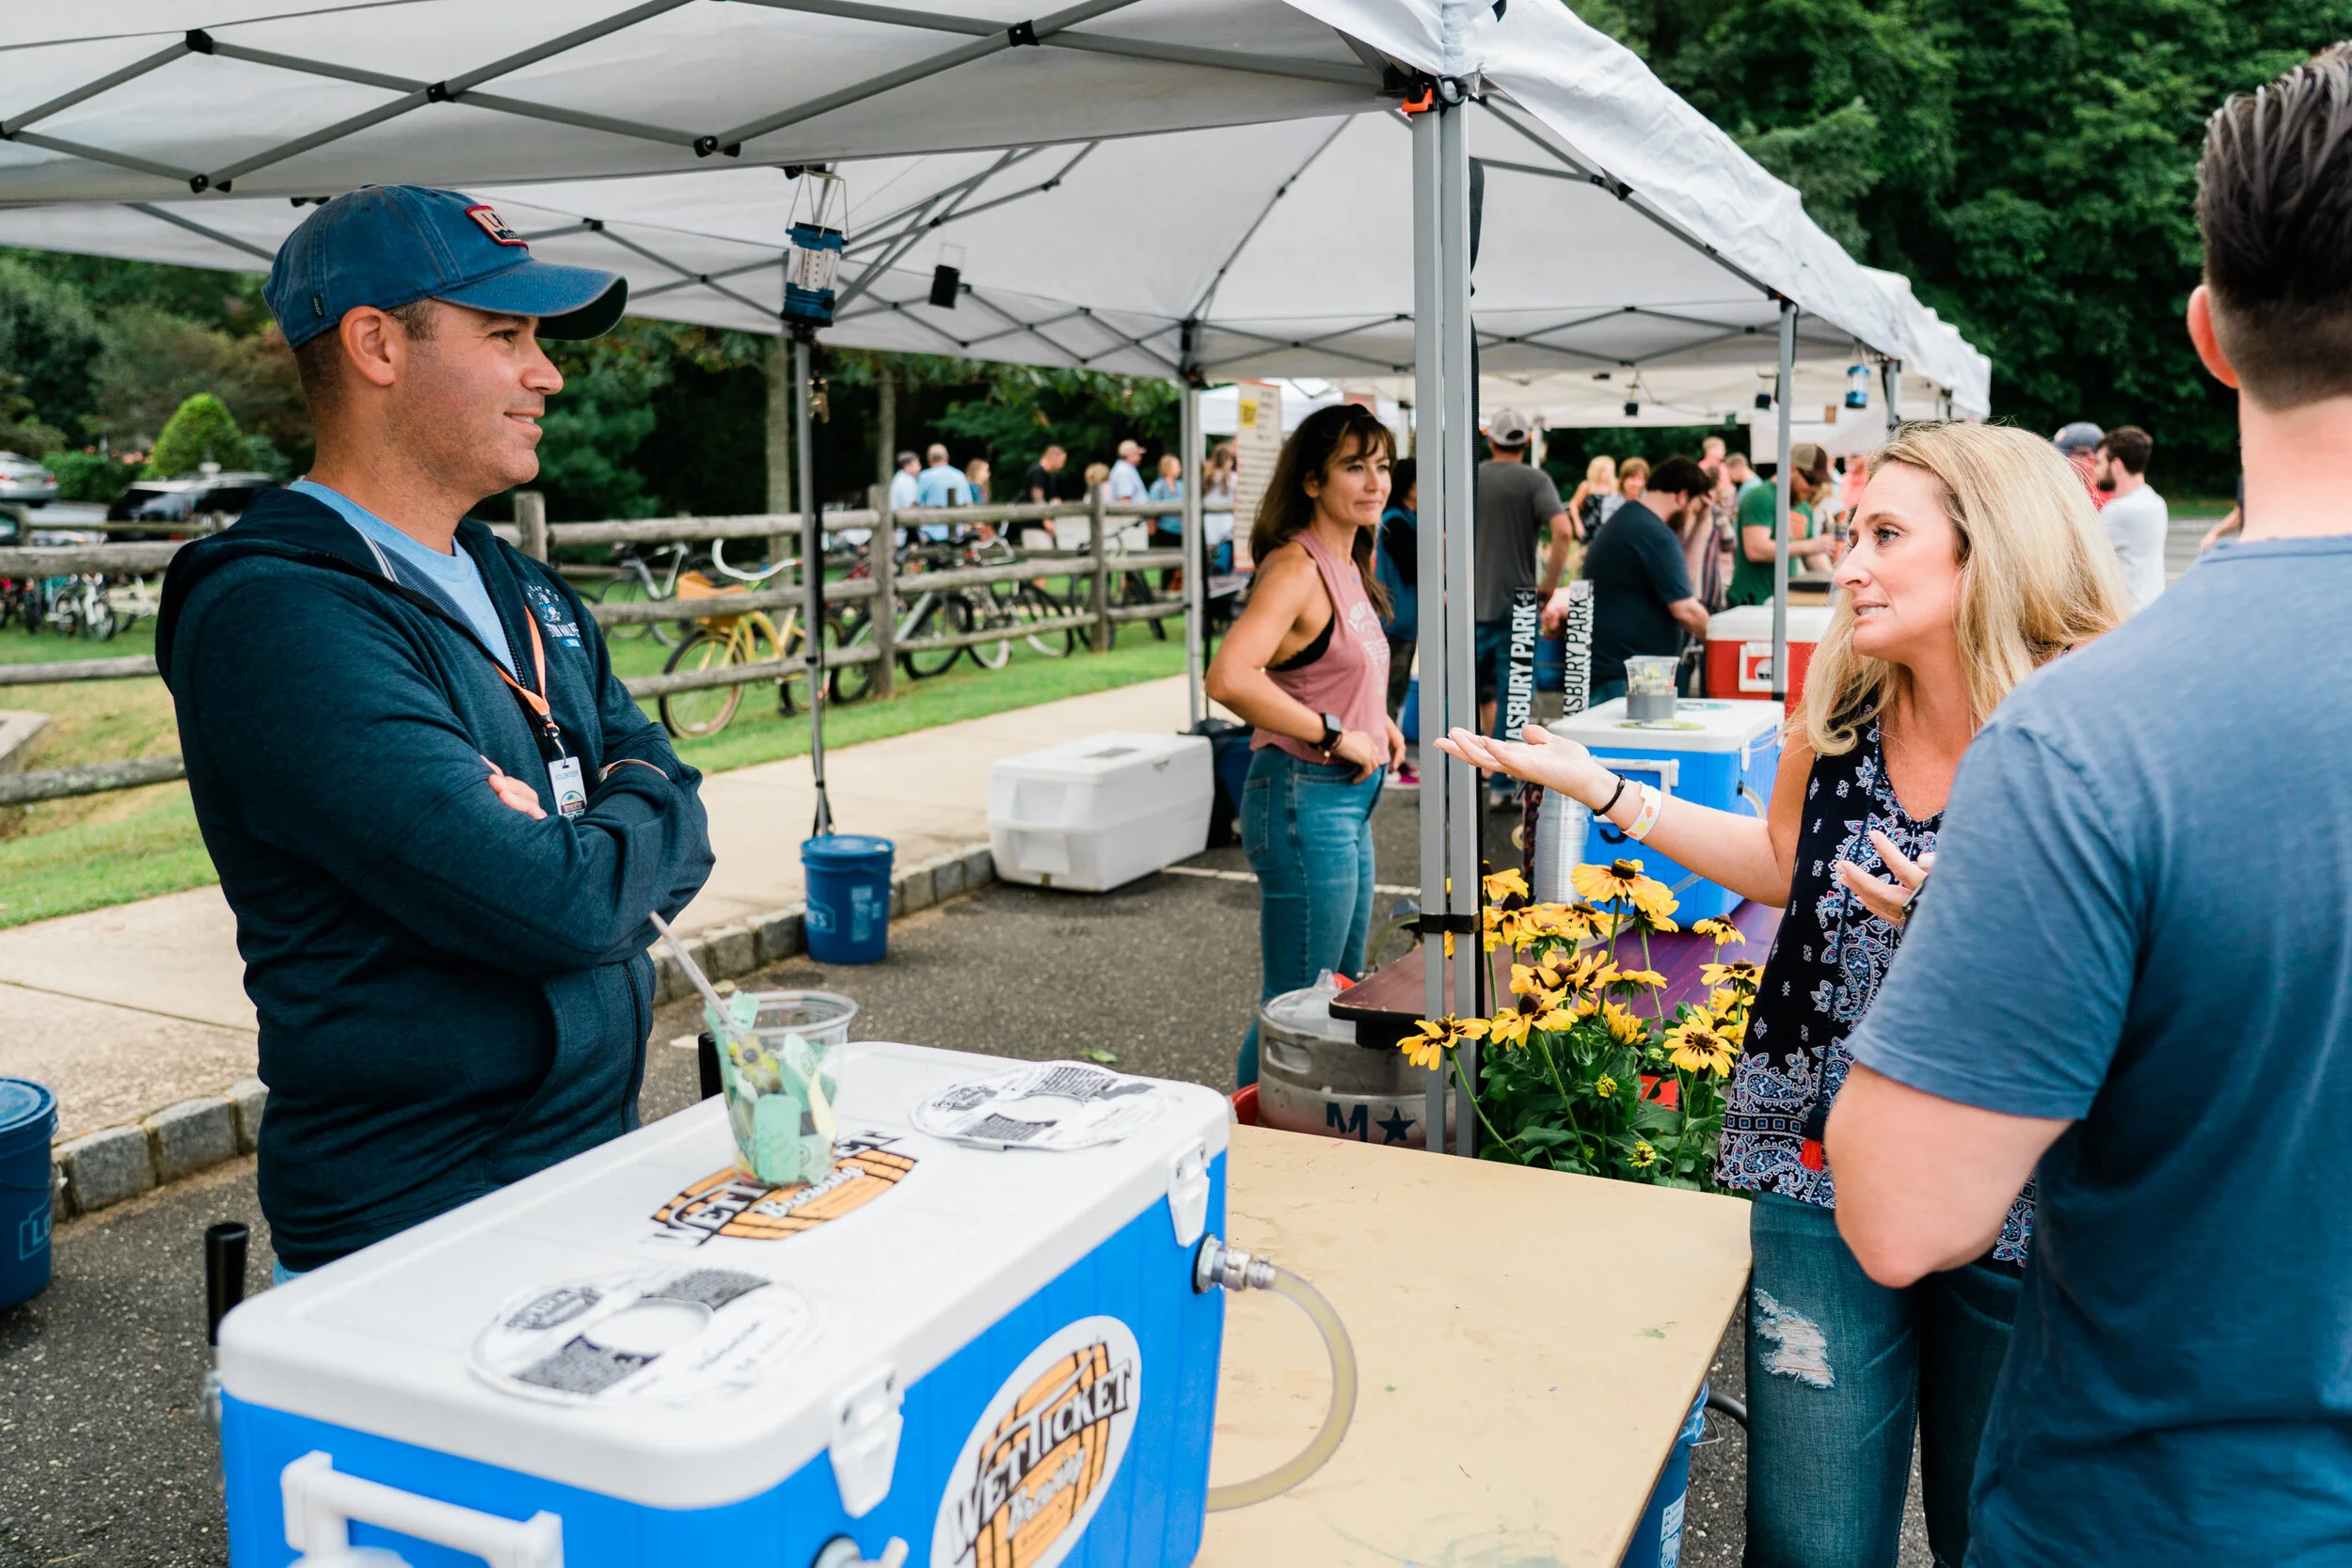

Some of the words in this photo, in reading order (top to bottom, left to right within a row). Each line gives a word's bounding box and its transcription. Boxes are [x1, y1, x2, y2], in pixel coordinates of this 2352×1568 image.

[1510, 603, 1537, 658] PARK
[1566, 597, 1588, 644] PARK
[1505, 660, 1534, 742] ASBURY
[946, 1434, 1028, 1565] WET
[1021, 1357, 1133, 1469] TICKET
